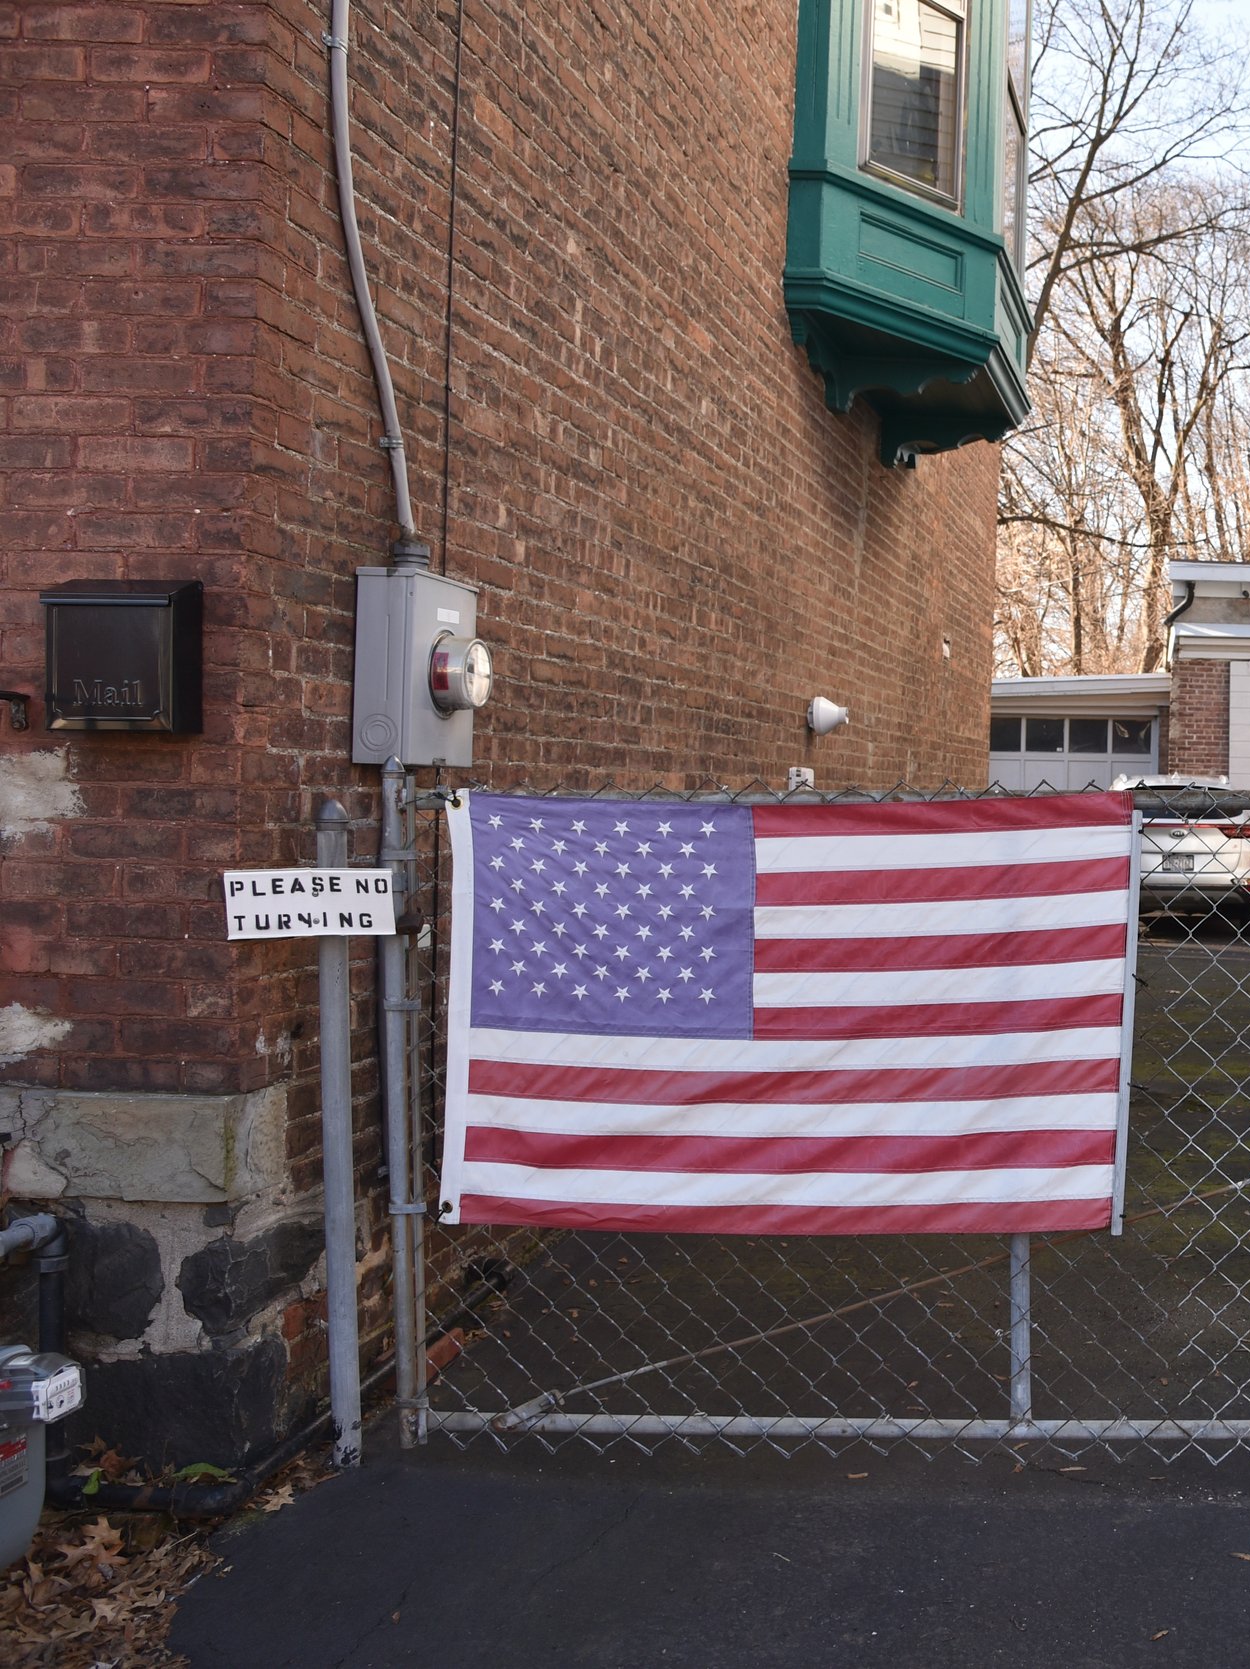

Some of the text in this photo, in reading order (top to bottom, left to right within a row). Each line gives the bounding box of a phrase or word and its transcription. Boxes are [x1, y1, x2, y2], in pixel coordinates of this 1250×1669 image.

[73, 679, 144, 706] Mail
[230, 877, 387, 896] PLEASE NO
